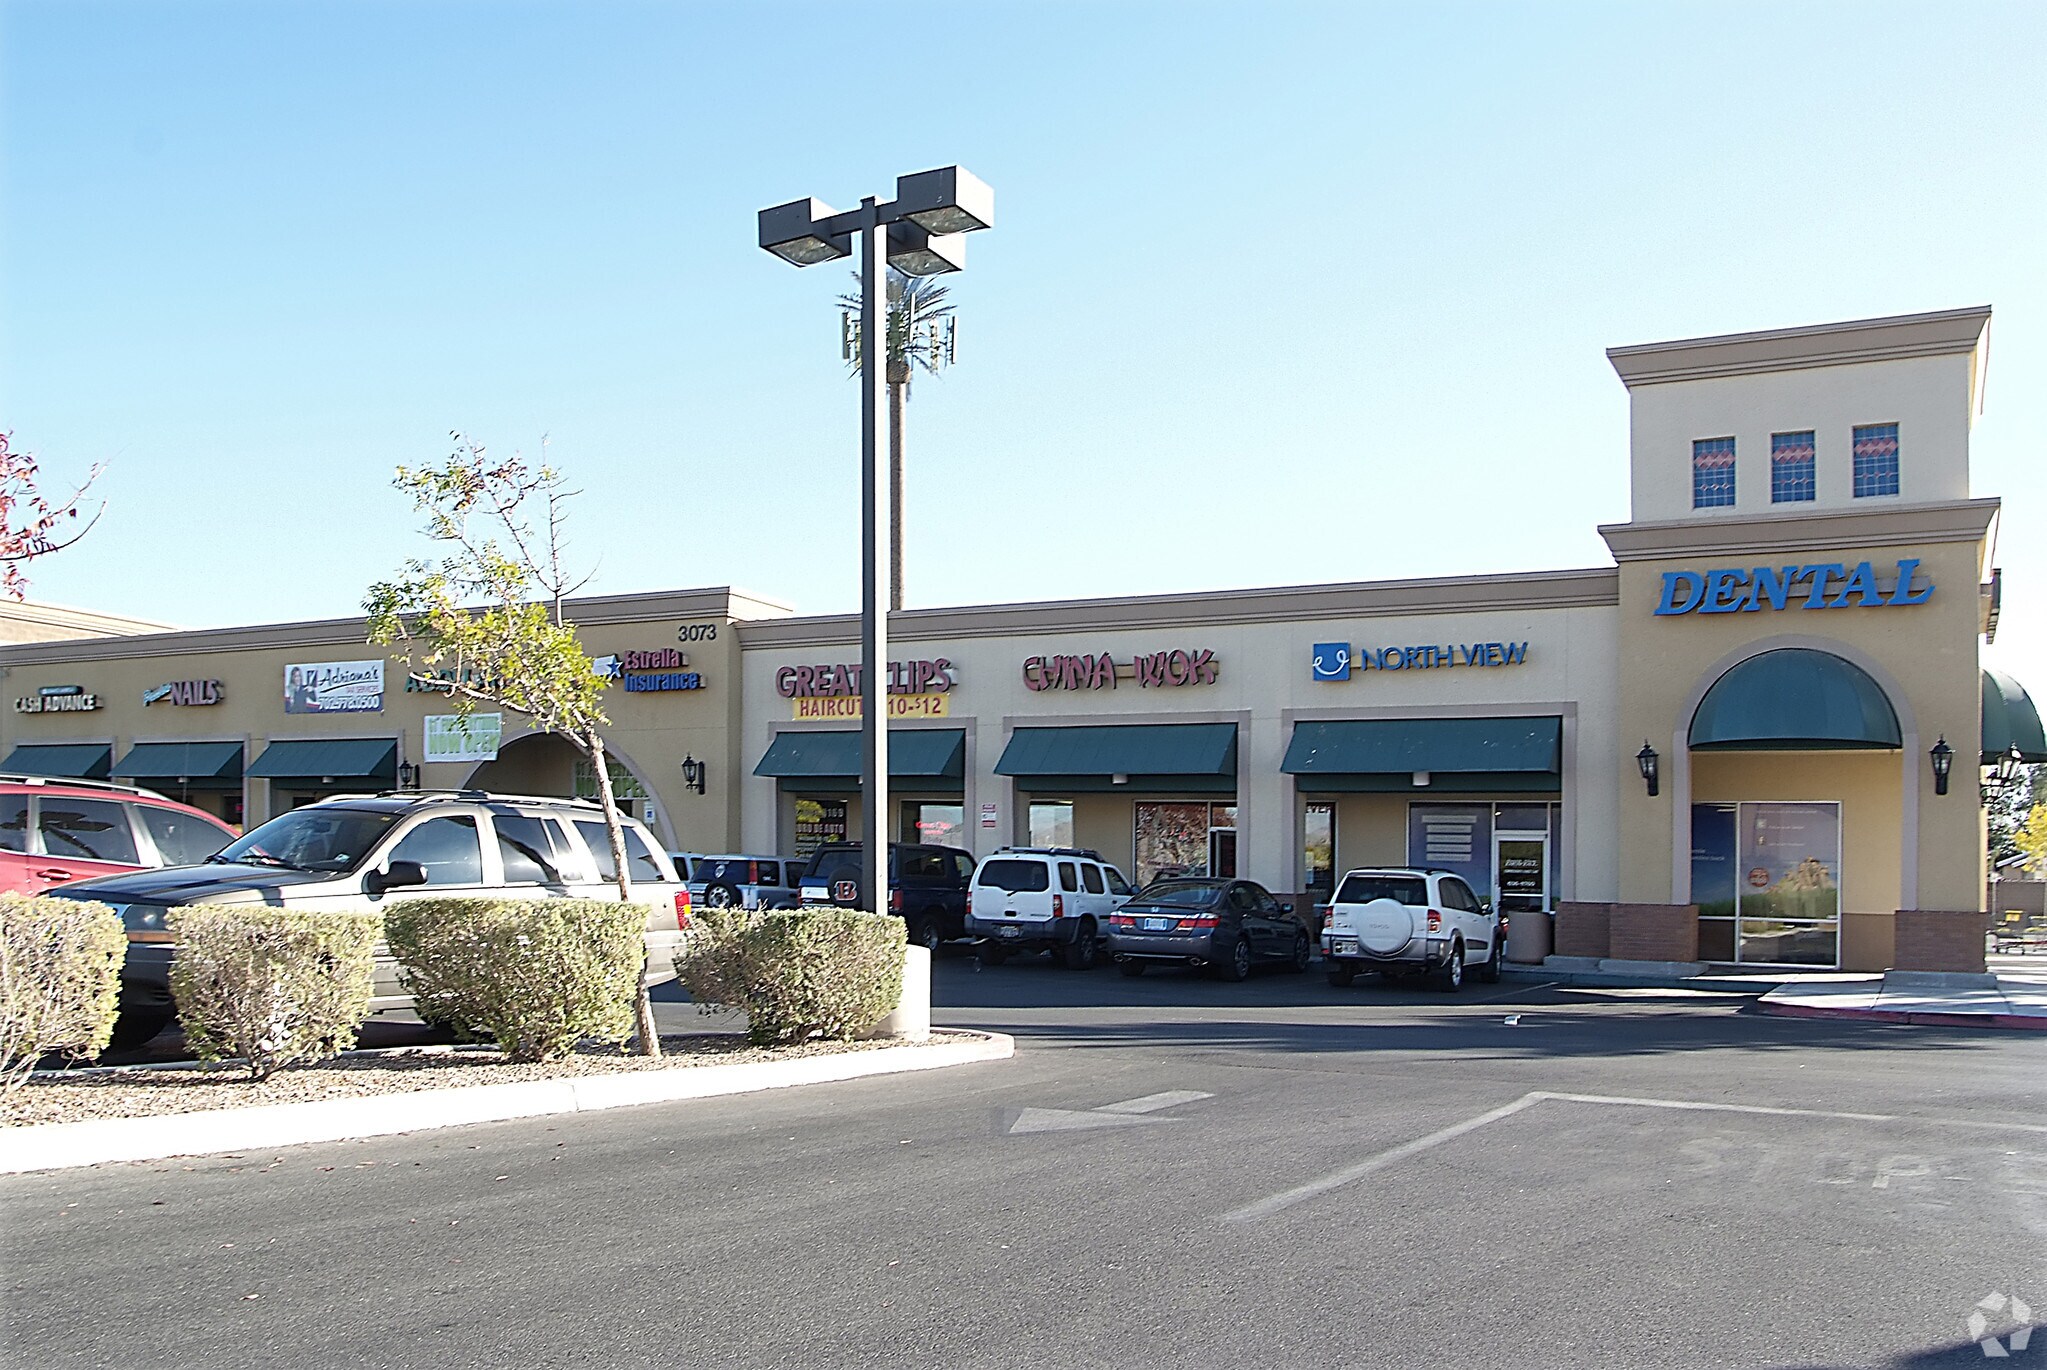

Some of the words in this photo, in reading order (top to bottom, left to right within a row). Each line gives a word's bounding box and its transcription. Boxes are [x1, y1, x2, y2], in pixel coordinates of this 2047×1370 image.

[1653, 558, 1936, 616] DENTAL
[678, 624, 717, 642] 3073
[624, 648, 682, 670] Estrella
[1362, 644, 1454, 671] NORTH
[1460, 641, 1528, 667] VIEW
[319, 665, 379, 686] Adriana's
[624, 672, 700, 692] Insurance
[776, 665, 863, 698] GREAT
[1023, 652, 1117, 691] CHINA
[1134, 649, 1214, 688] WOK
[13, 698, 44, 713] CASH
[44, 694, 97, 711] ADVANCE
[171, 679, 219, 706] NAILS
